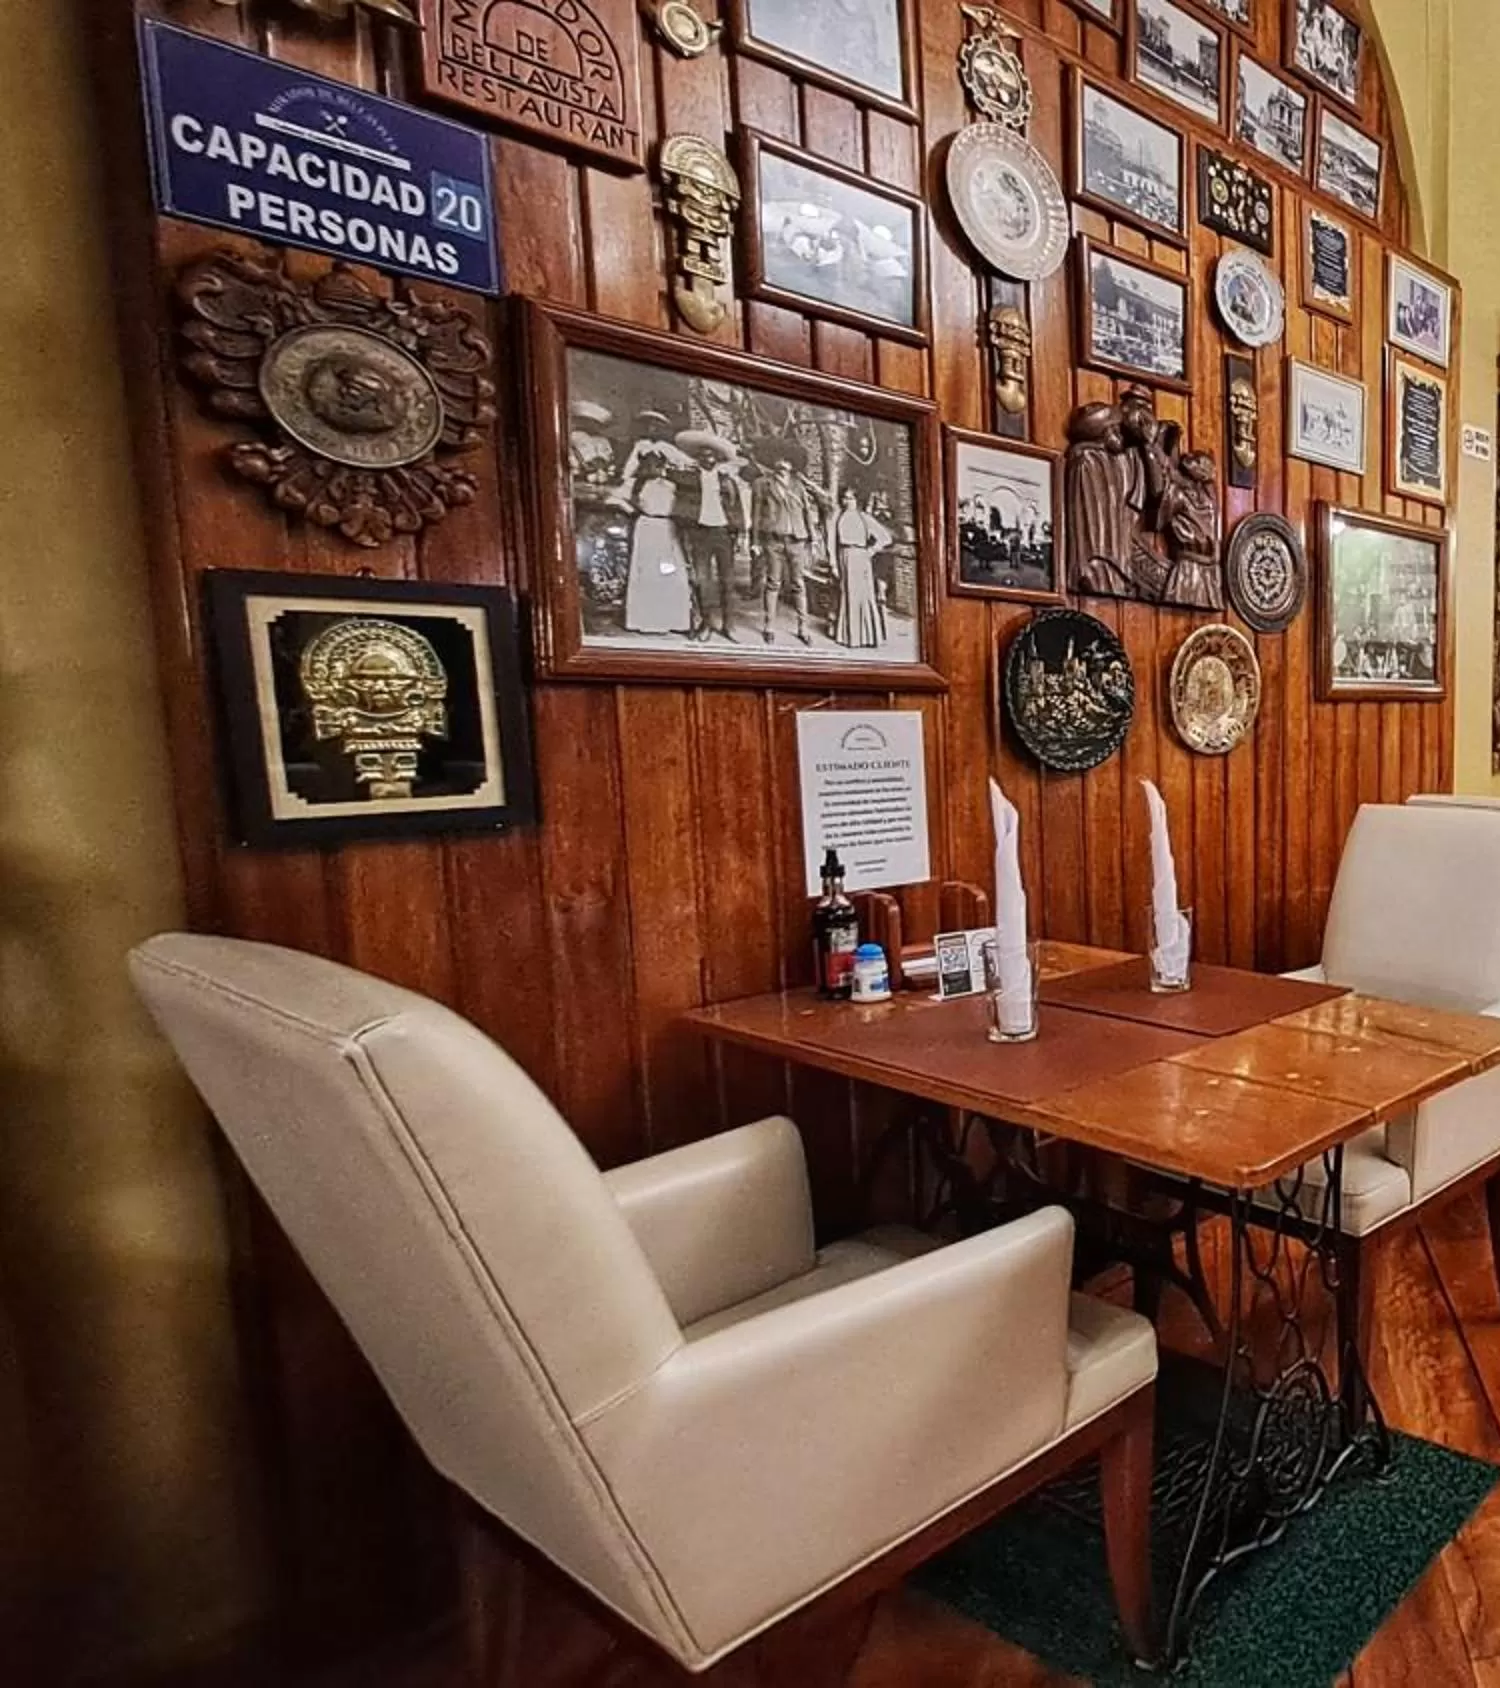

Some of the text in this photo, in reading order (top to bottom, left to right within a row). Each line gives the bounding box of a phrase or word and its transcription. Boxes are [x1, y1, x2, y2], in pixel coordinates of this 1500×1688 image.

[450, 33, 617, 116] BELLAVISTA
[452, 0, 614, 81] MDOR
[516, 29, 549, 63] DE
[437, 60, 640, 156] RESTAURANT
[171, 114, 426, 218] CAPACIDAD
[435, 187, 482, 233] 20
[226, 183, 460, 276] PERSONAS
